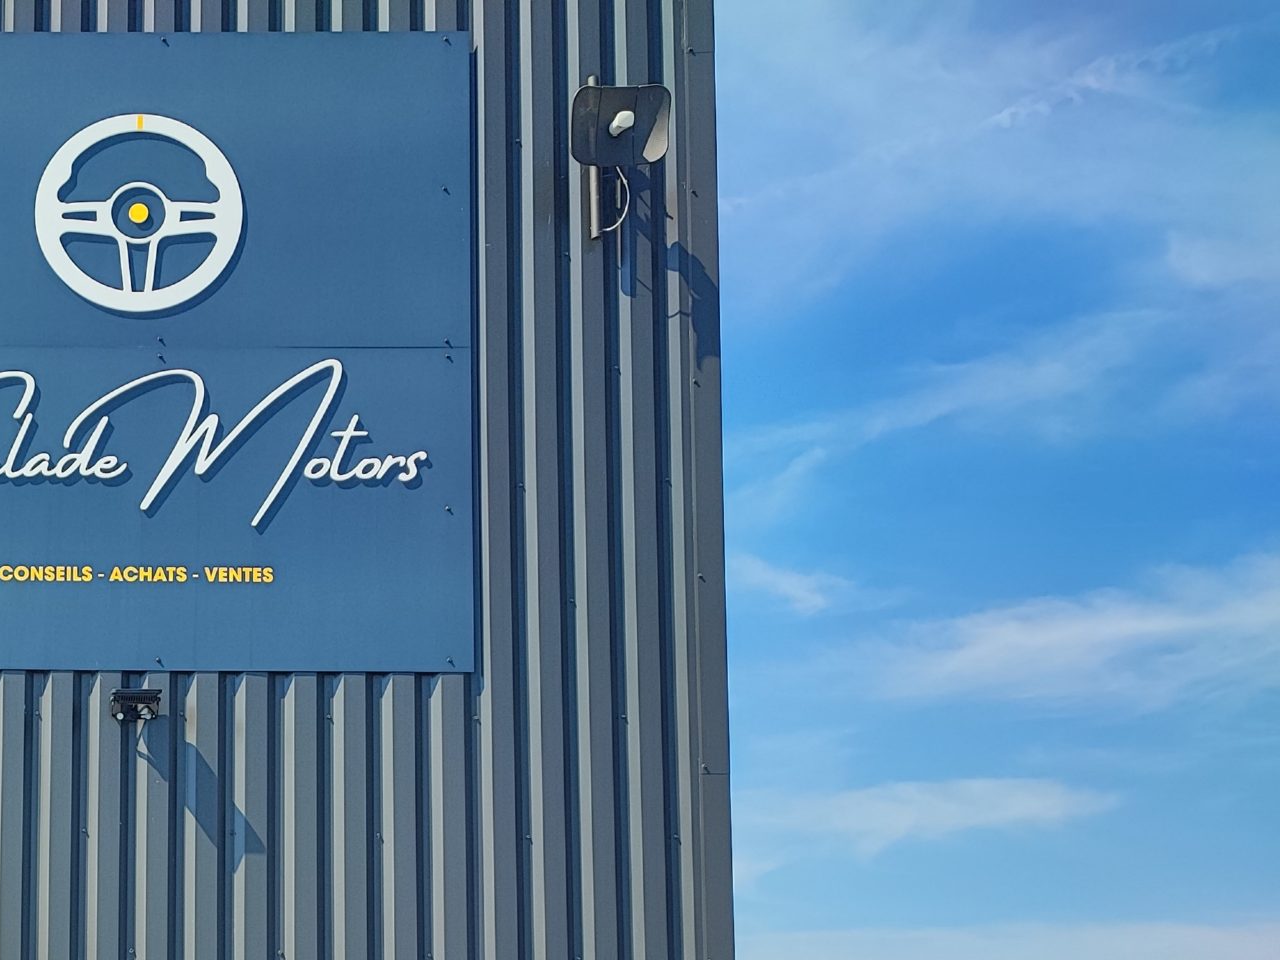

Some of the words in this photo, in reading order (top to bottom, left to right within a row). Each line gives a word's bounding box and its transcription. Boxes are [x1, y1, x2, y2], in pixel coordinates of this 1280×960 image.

[64, 358, 428, 527] Motors
[109, 566, 188, 583] ACHATS
[204, 566, 274, 583] VENTES
